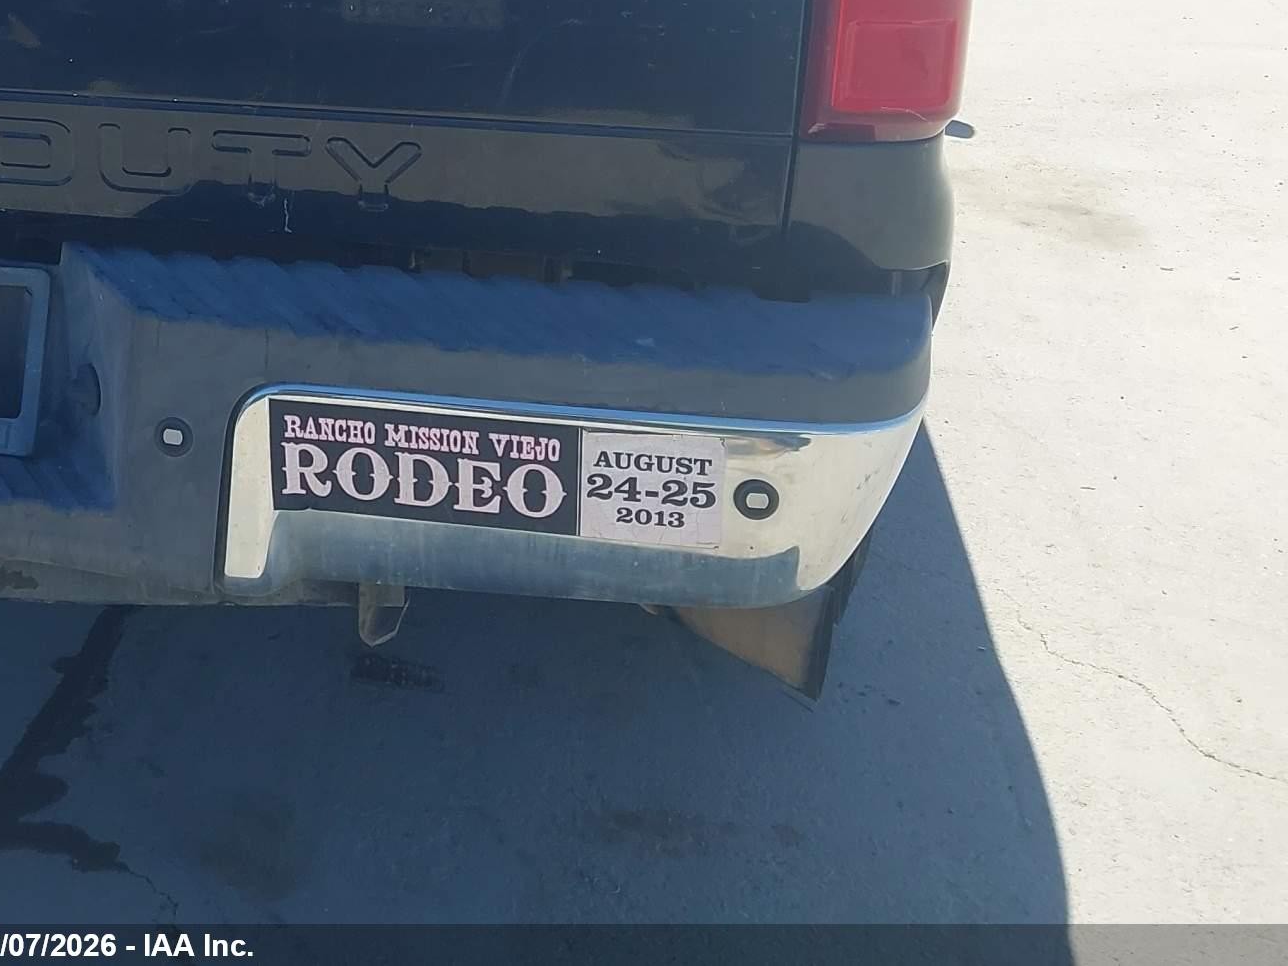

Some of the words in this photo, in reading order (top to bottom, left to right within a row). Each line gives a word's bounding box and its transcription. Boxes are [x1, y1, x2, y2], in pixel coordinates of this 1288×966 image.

[283, 414, 376, 445] RANCHO
[384, 423, 480, 456] MISSION
[488, 433, 561, 462] VIEJO
[280, 441, 567, 519] RODEO
[593, 450, 713, 477] AUGUST
[586, 474, 717, 509] 24-25
[615, 507, 685, 528] 2013
